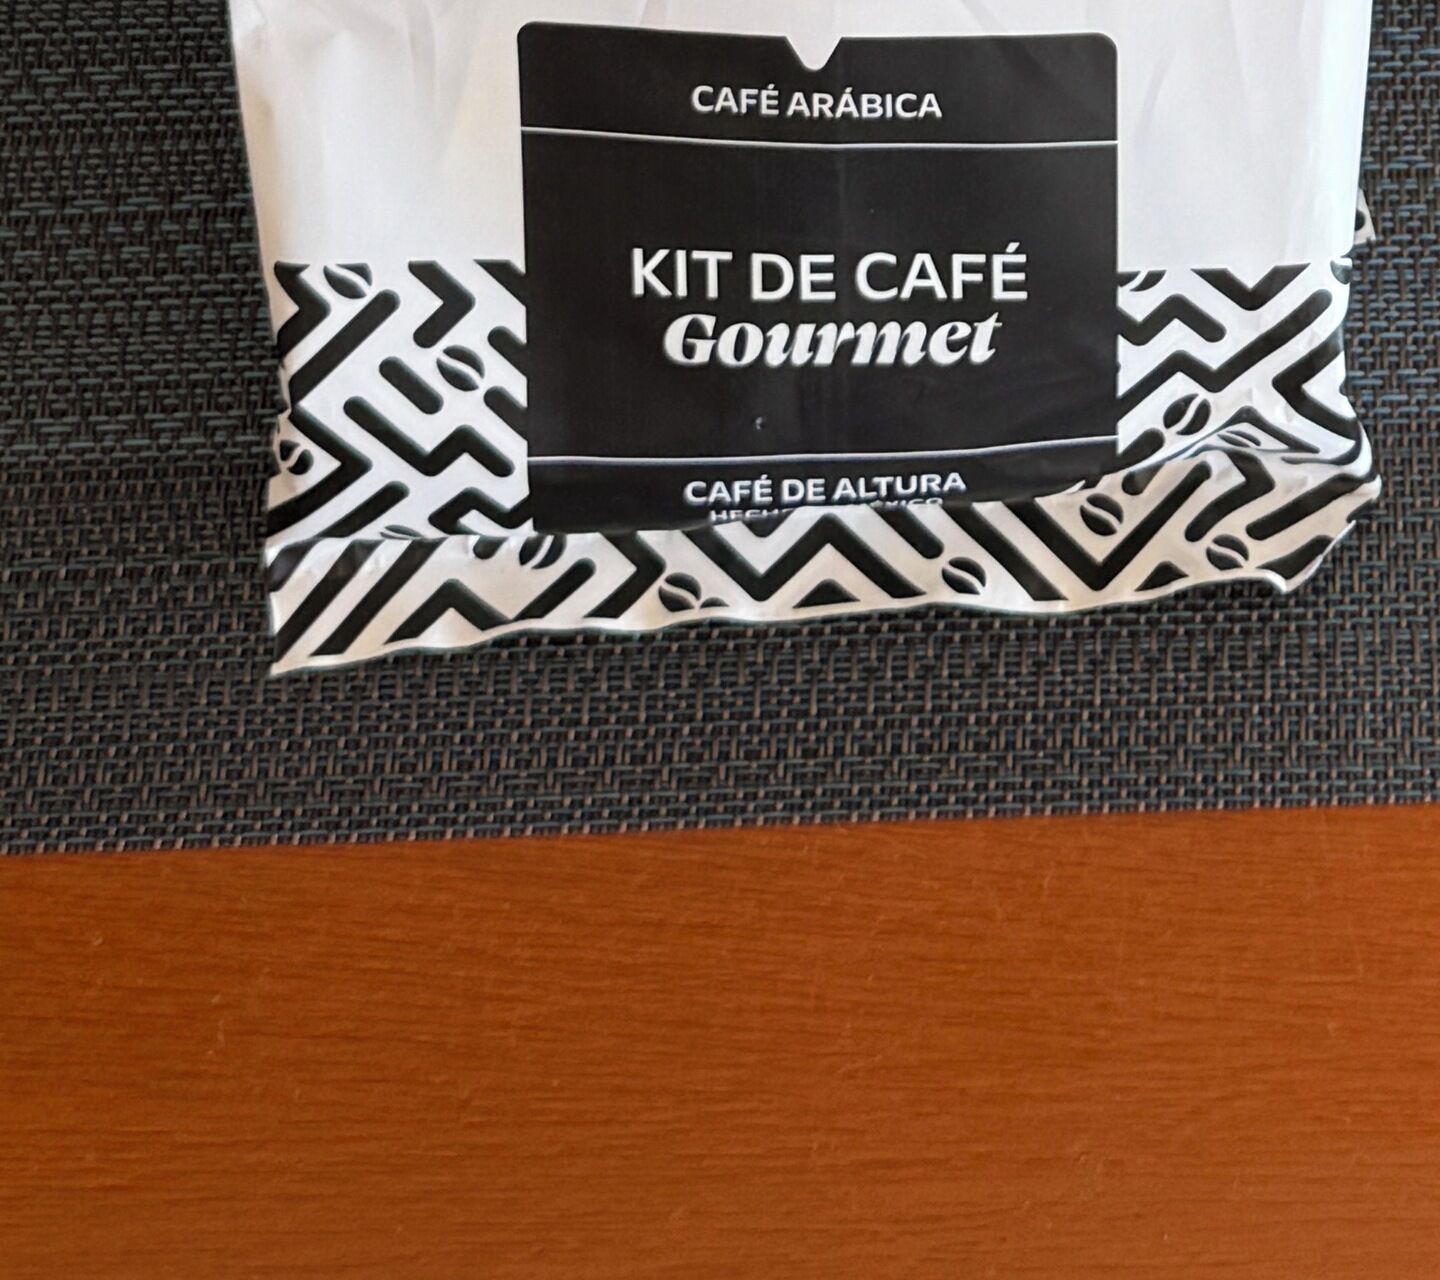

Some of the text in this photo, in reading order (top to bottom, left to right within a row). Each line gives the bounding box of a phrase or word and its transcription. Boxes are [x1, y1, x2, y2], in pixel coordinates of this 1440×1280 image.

[691, 84, 943, 120] CAFÉ ARÁBICA
[630, 241, 1029, 301] KIT DE CAFÉ
[663, 311, 1003, 368] Gourmet
[683, 470, 967, 506] CAFÉ DE ALTURA
